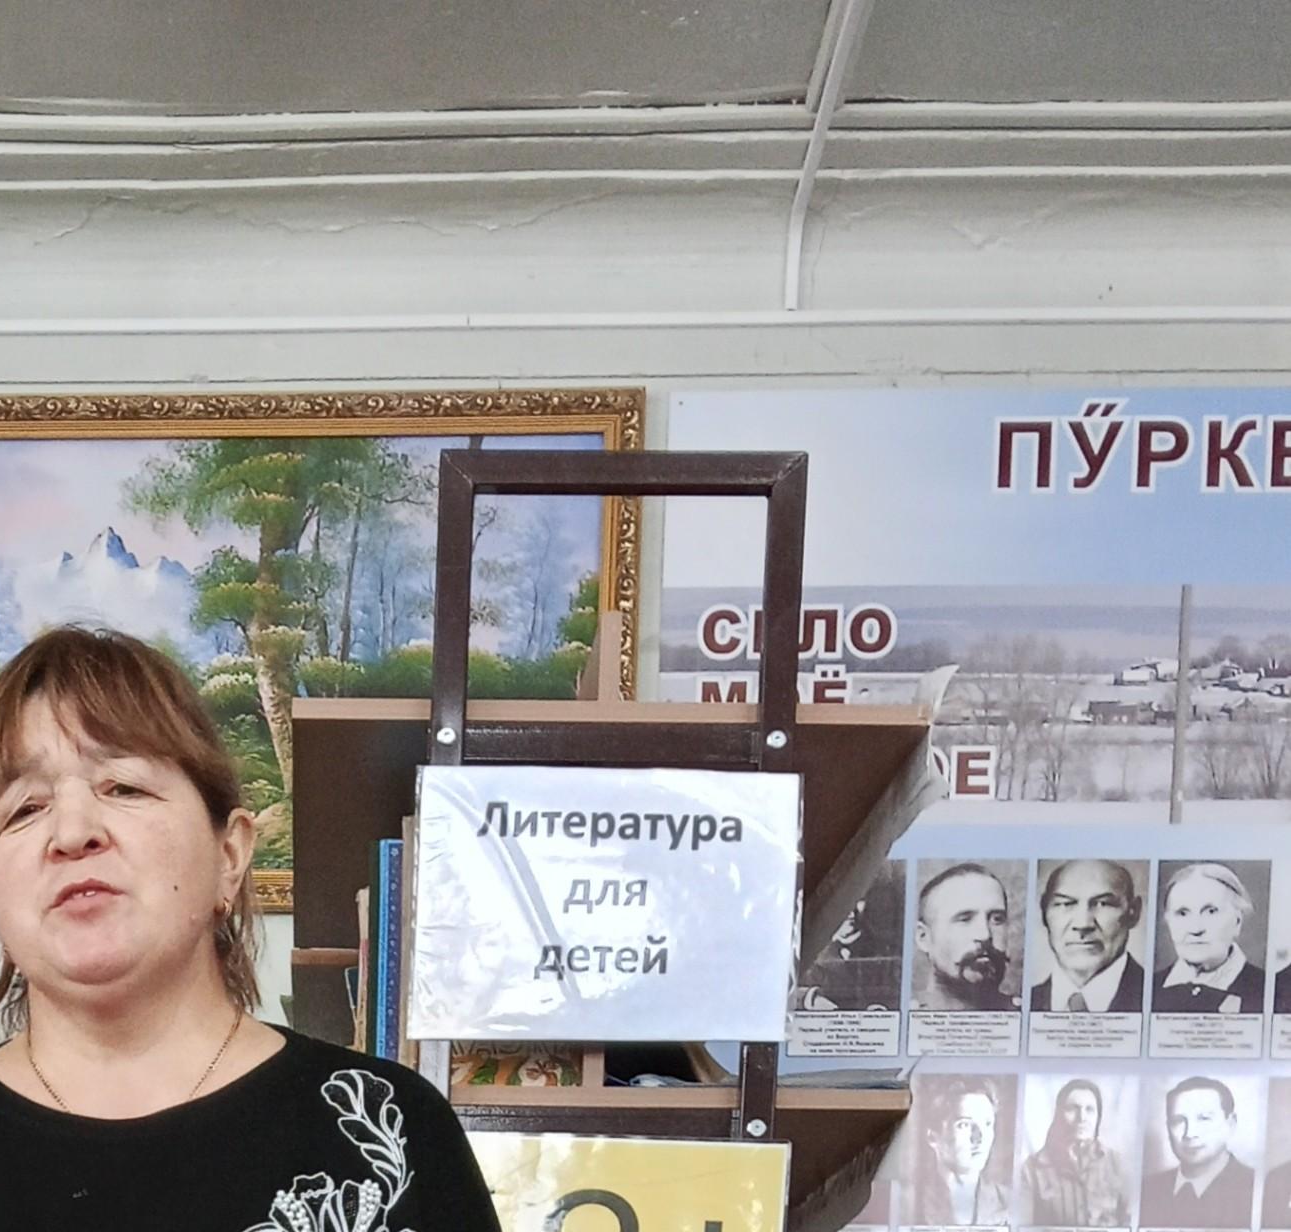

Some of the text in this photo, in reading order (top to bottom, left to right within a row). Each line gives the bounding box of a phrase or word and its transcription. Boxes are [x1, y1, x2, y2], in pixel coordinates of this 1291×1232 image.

[702, 608, 892, 654] СЛО
[701, 670, 848, 704] МЁ
[477, 801, 743, 851] Литература
[563, 879, 648, 914] для
[533, 935, 669, 981] детей
